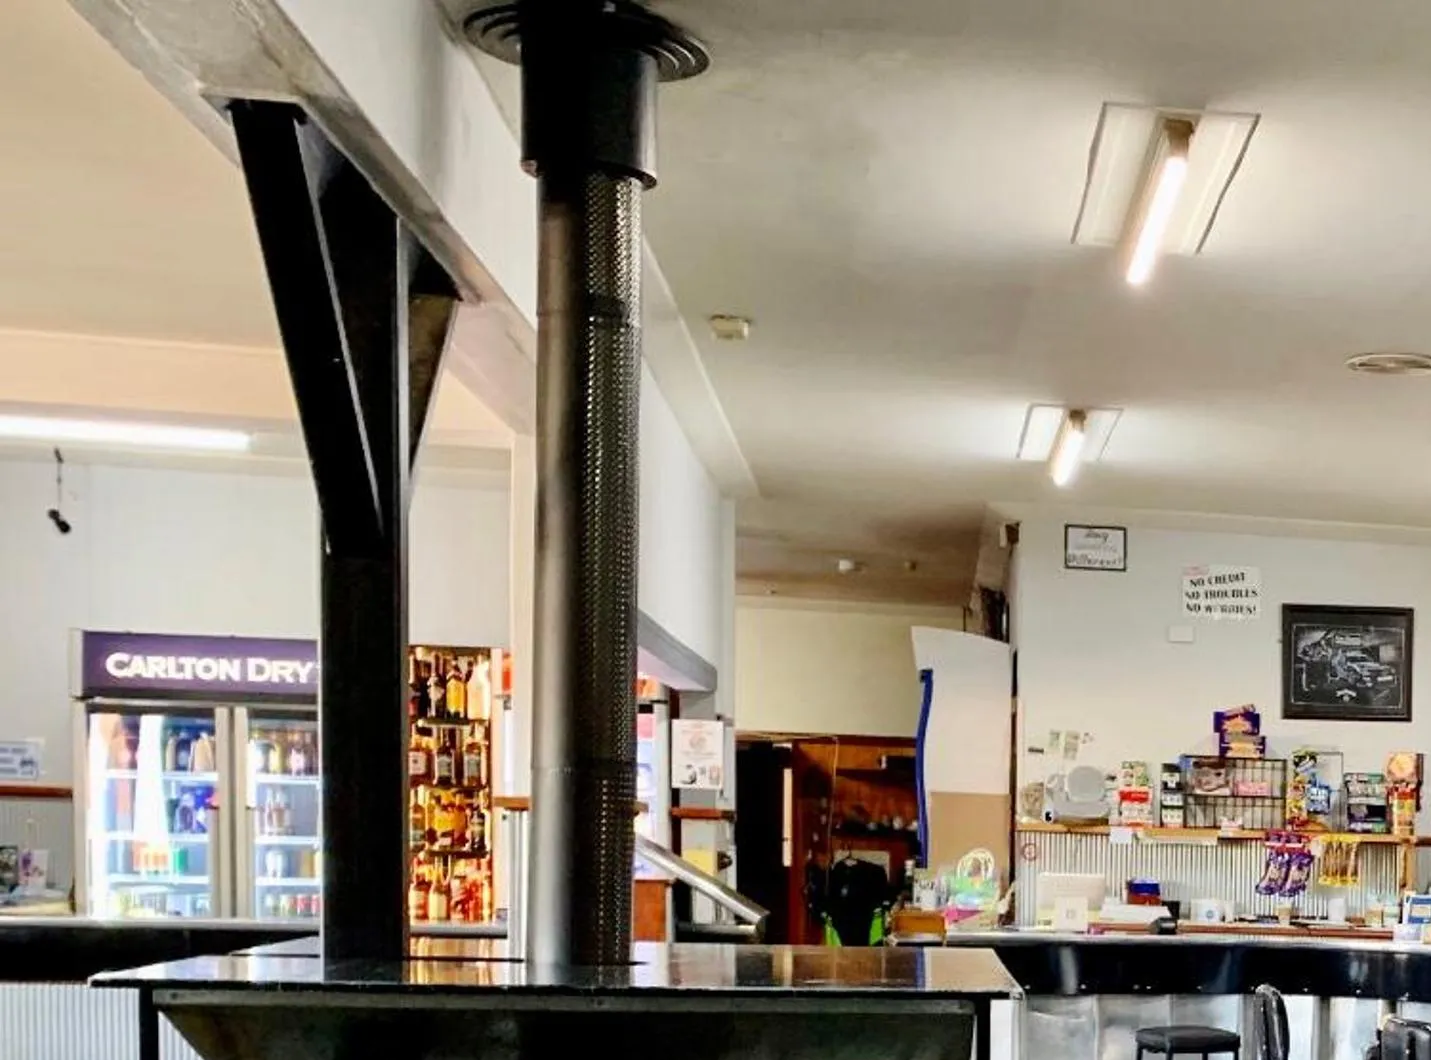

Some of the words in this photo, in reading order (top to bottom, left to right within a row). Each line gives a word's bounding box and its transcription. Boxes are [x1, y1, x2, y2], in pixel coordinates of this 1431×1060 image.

[1190, 578, 1205, 587] NO
[1185, 590, 1201, 600] NO
[1186, 602, 1202, 613] NO
[105, 652, 241, 681] CARLTON
[246, 657, 315, 684] DRY
